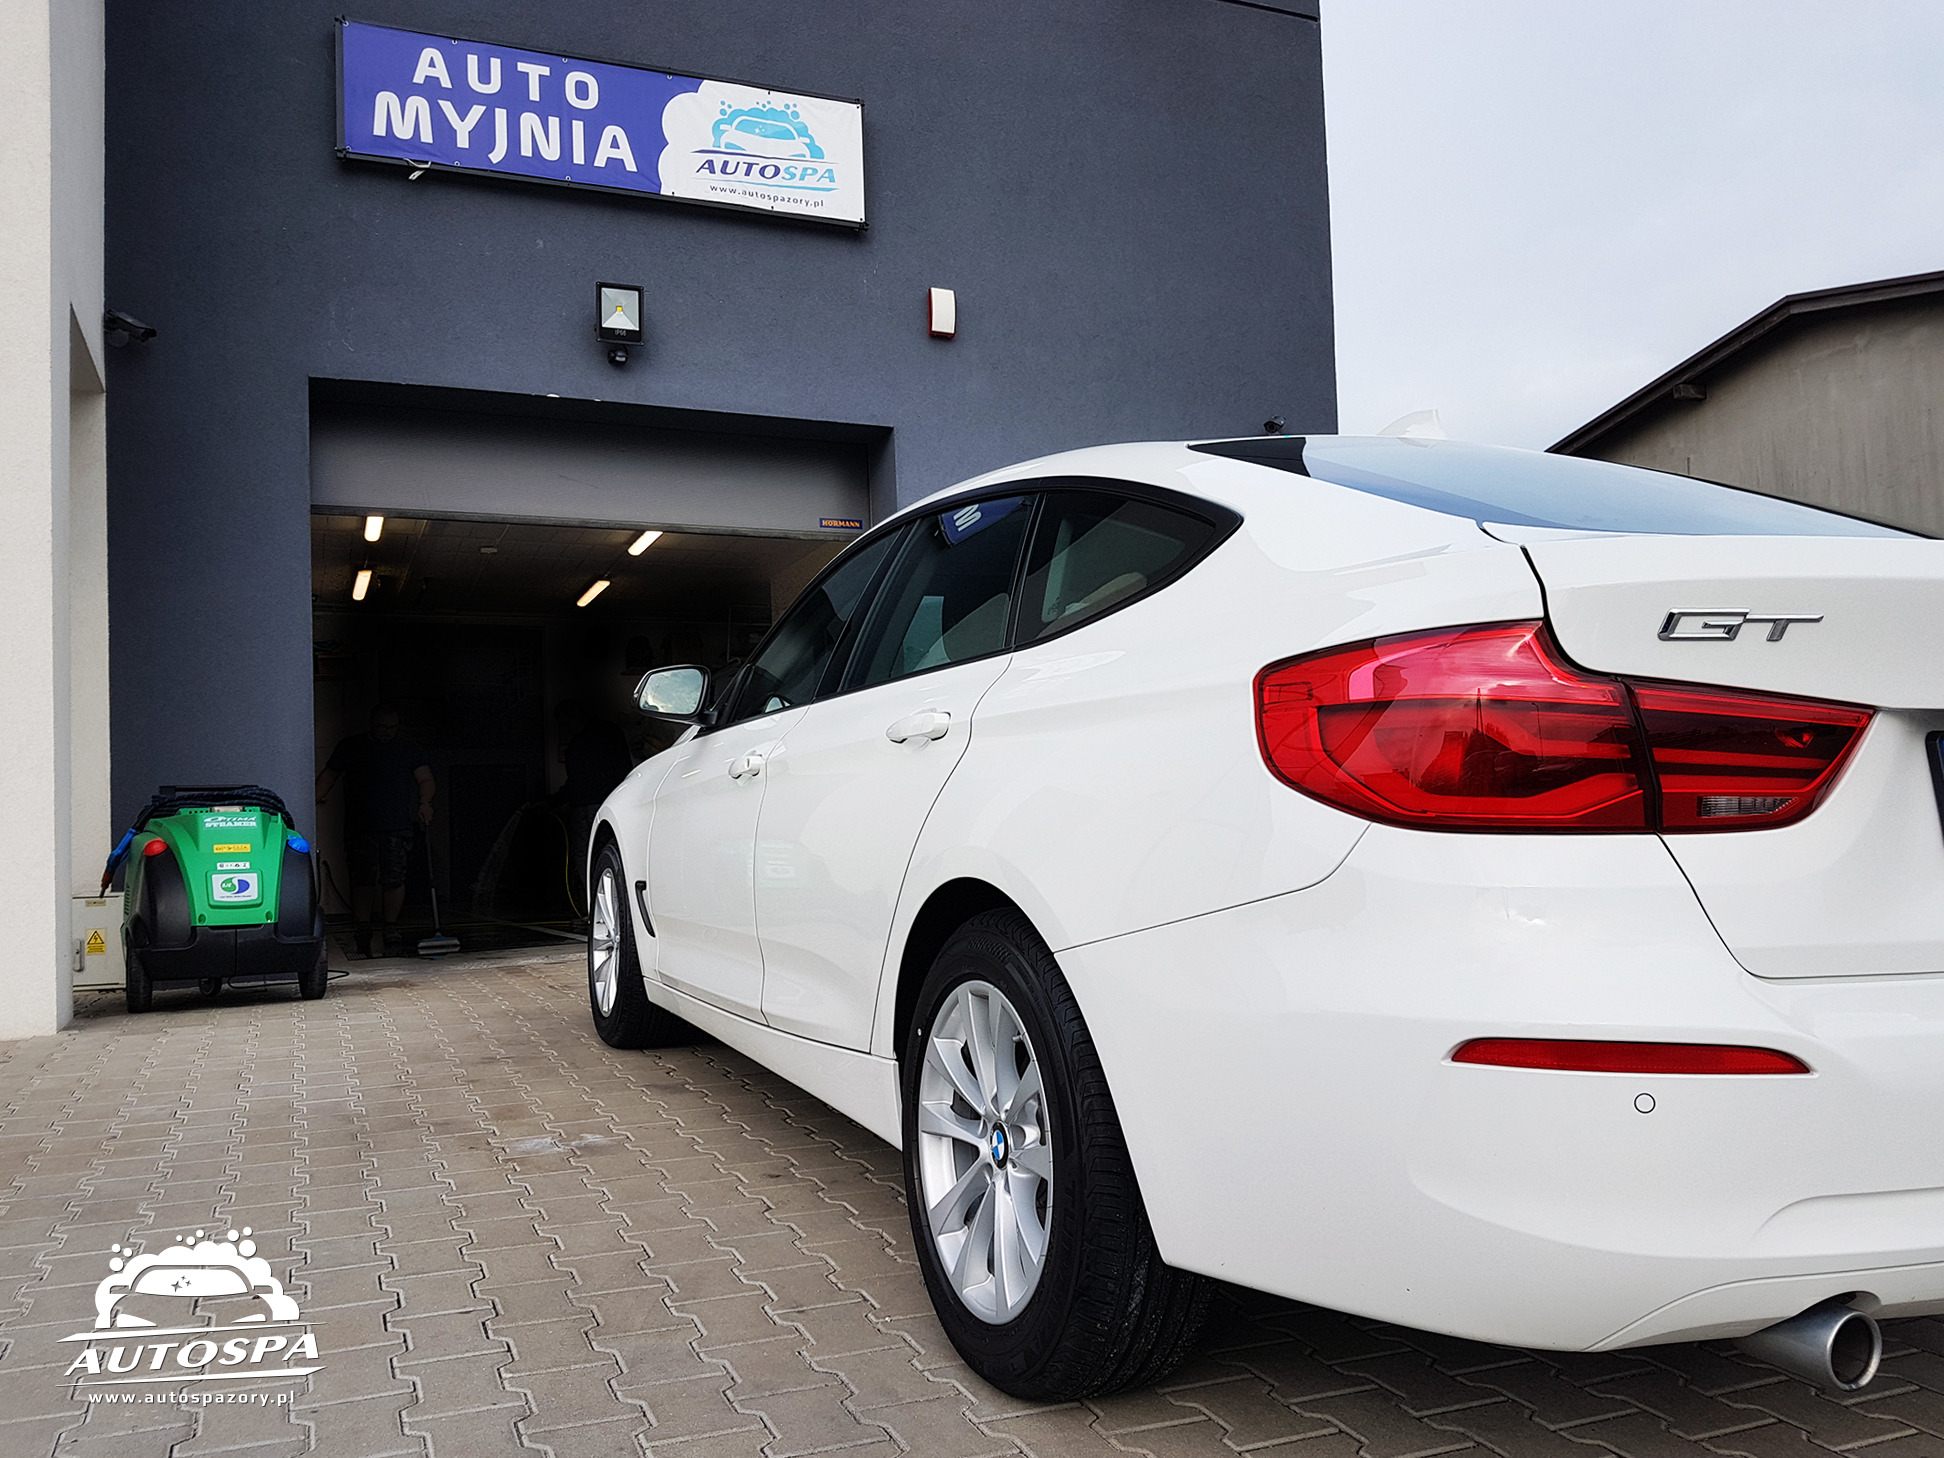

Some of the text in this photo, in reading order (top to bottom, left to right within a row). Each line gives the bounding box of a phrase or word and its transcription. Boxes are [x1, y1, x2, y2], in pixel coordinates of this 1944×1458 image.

[412, 46, 599, 110] AUTO
[372, 90, 638, 173] MYJNIA
[696, 157, 838, 185] AUTOSPA
[709, 184, 825, 207] www.autospazory.pl
[1657, 607, 1824, 642] GT
